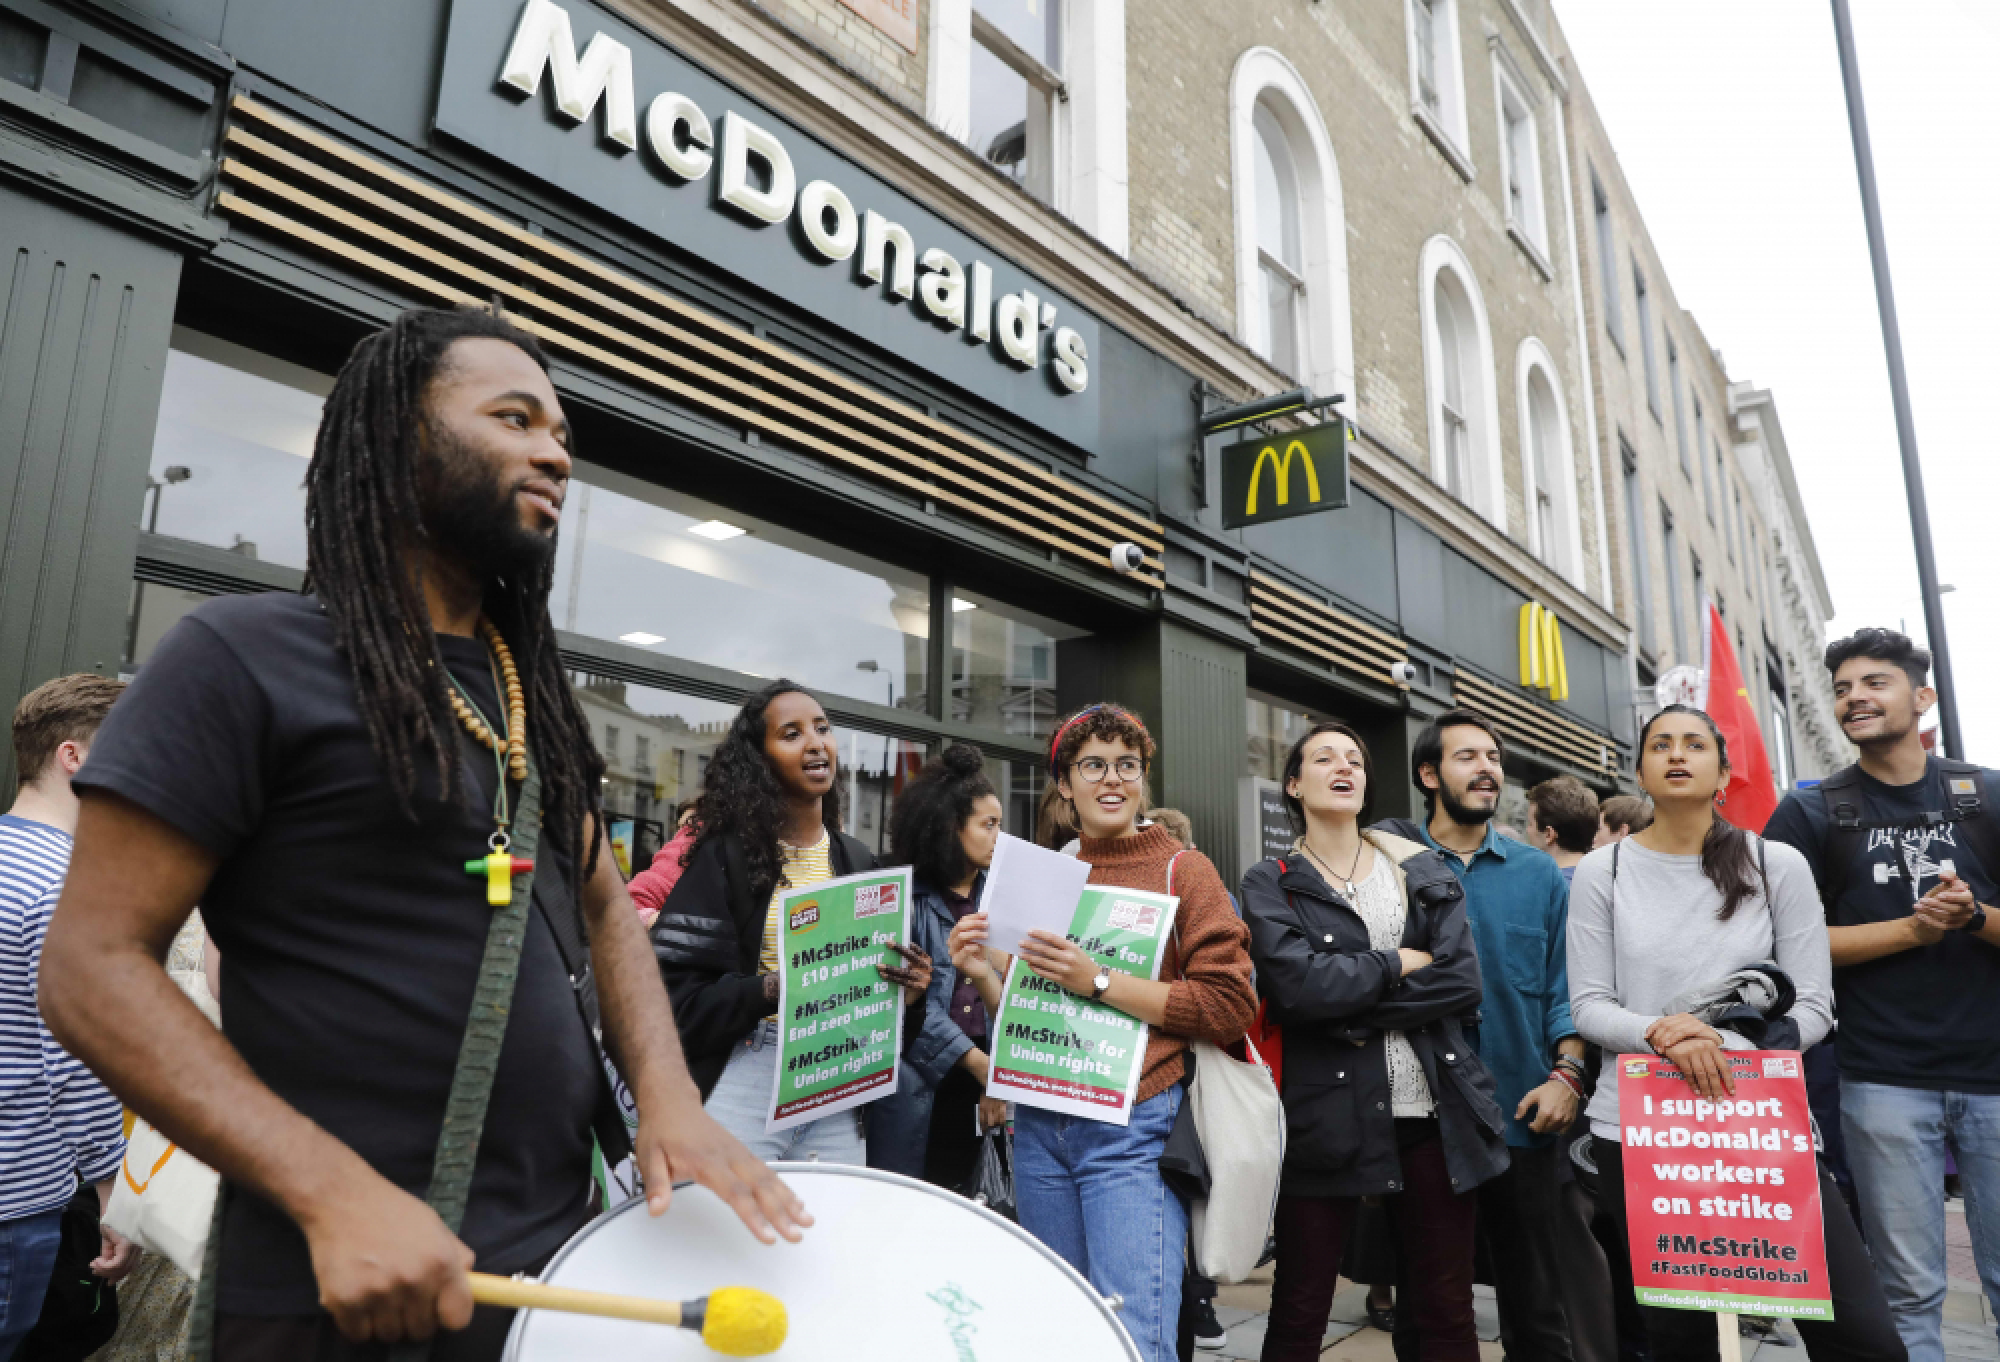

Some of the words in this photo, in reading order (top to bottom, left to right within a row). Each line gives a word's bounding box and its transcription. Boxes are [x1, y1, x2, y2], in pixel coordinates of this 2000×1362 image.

[499, 0, 1089, 394] McDonald's
[791, 935, 870, 969] #McStrike
[871, 930, 897, 945] for
[1119, 945, 1148, 966] for
[801, 965, 829, 989] £10
[831, 963, 849, 977] an
[851, 951, 885, 973] hour
[793, 985, 872, 1021] #McStrike
[873, 981, 889, 995] to
[1009, 993, 1039, 1011] End
[1039, 1001, 1077, 1018] zero
[1081, 1005, 1133, 1031] hours
[789, 1019, 817, 1043] End
[819, 1010, 851, 1033] zero
[853, 997, 893, 1020] hours
[787, 1035, 868, 1073] #McStrike
[869, 1027, 891, 1043] for
[1005, 1022, 1095, 1053] #McStrike
[1097, 1039, 1127, 1059] for
[793, 1065, 839, 1089] Union
[841, 1048, 884, 1074] rights
[1009, 1043, 1055, 1065] Union
[1057, 1052, 1113, 1077] rights
[1643, 1094, 1653, 1116] I
[1660, 1097, 1783, 1123] support
[1625, 1125, 1809, 1152] McDonald's
[1651, 1159, 1785, 1186] workers
[1651, 1196, 1691, 1215] on
[1699, 1193, 1793, 1221] strike
[1656, 1233, 1799, 1262] #McStrike
[1650, 1260, 1809, 1285] #FastFoodGlobal
